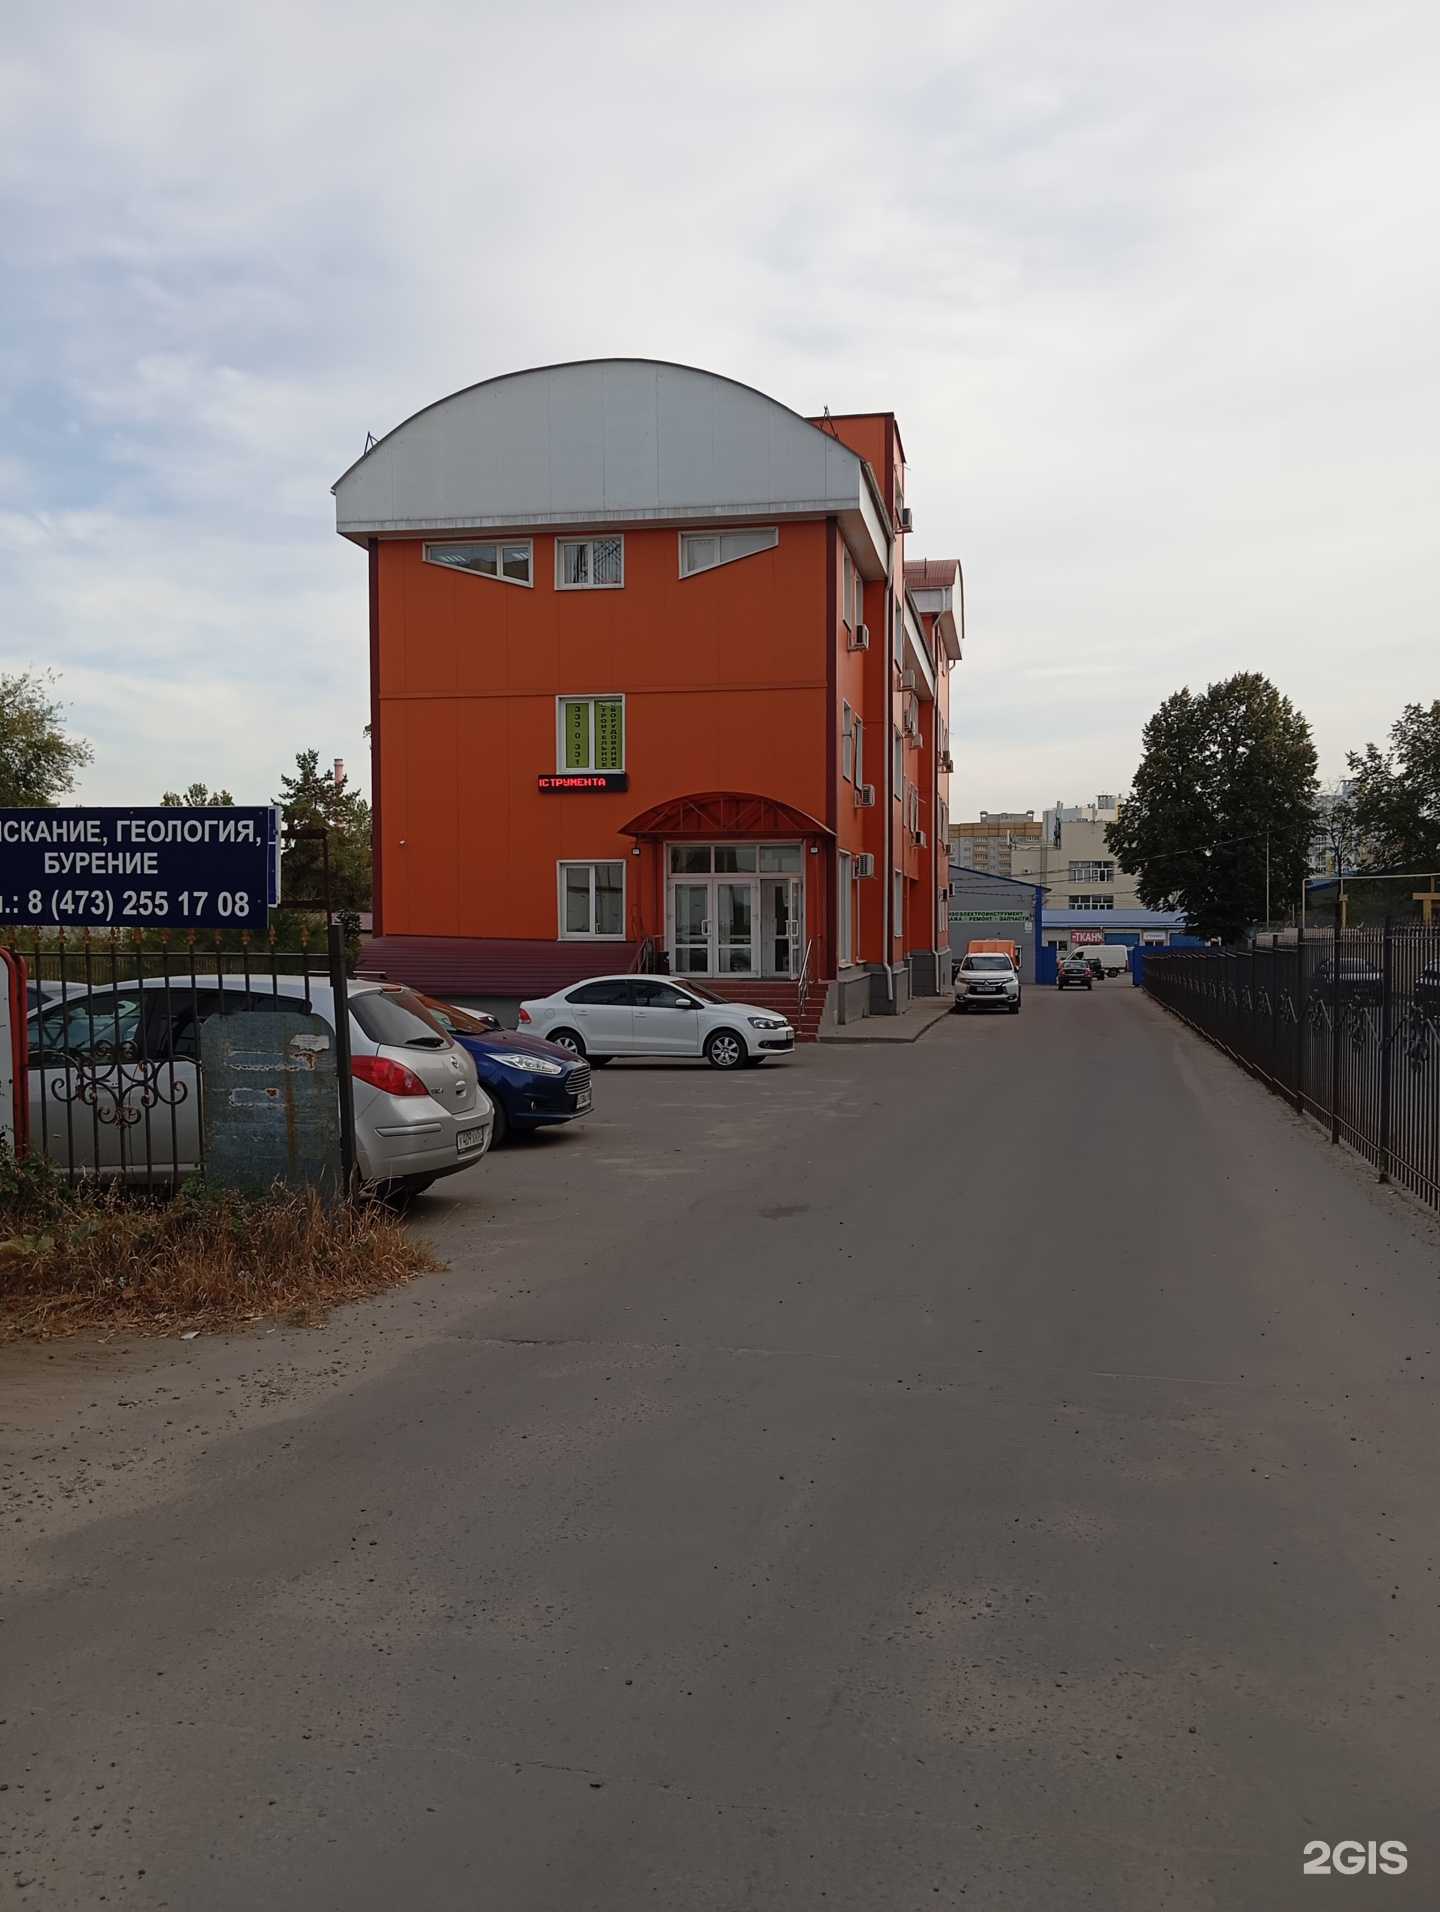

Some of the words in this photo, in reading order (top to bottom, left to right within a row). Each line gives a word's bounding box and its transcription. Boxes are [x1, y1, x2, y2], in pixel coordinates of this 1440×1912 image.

[0, 820, 108, 846] СКАНИЕ,
[116, 820, 261, 846] ГЕОЛОГИЯ,
[44, 852, 158, 874] БУРЕНИЕ
[28, 889, 42, 914] 8
[51, 889, 114, 921] (473)
[122, 890, 169, 916] 255
[178, 891, 208, 916] 17
[217, 891, 250, 917] 08
